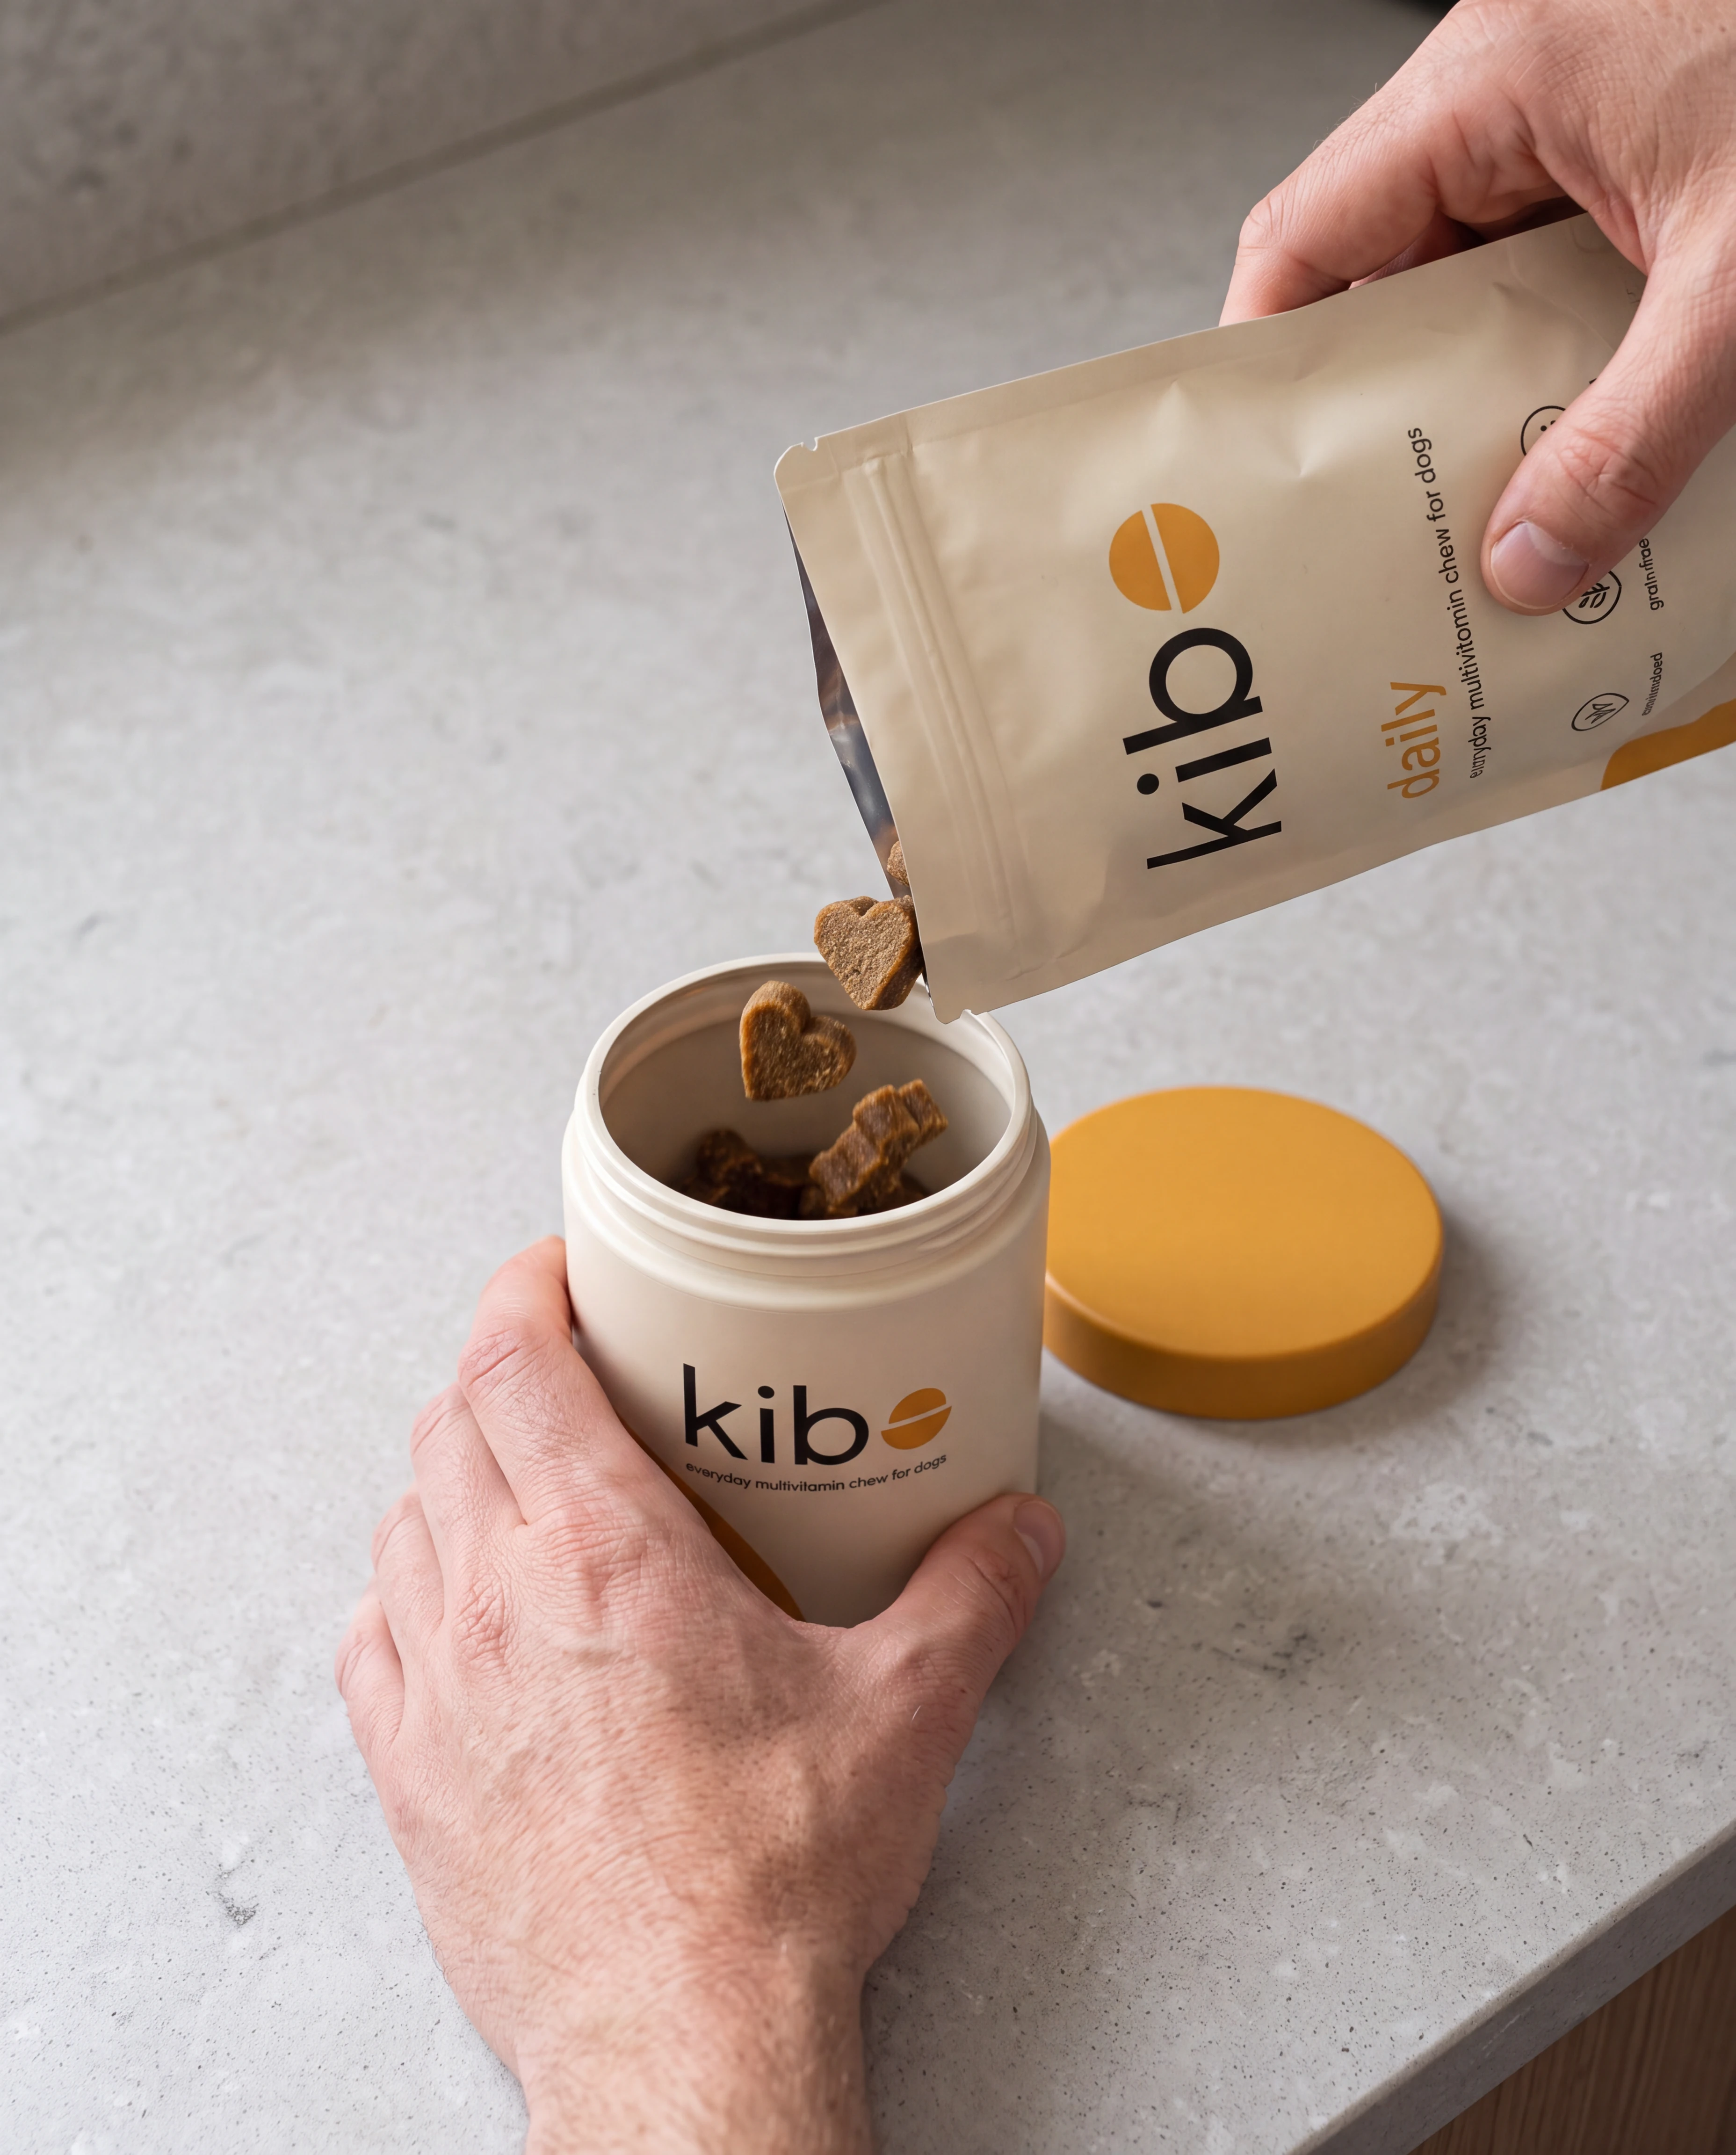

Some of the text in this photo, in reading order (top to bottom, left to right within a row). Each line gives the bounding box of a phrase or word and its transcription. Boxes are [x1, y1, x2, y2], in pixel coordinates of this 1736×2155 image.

[1408, 427, 1436, 484] dogs
[1426, 491, 1446, 522] for
[1435, 528, 1460, 584] chew
[1381, 682, 1447, 799] daily
[686, 1454, 947, 1492] everyday multivitamin chew for dogs
